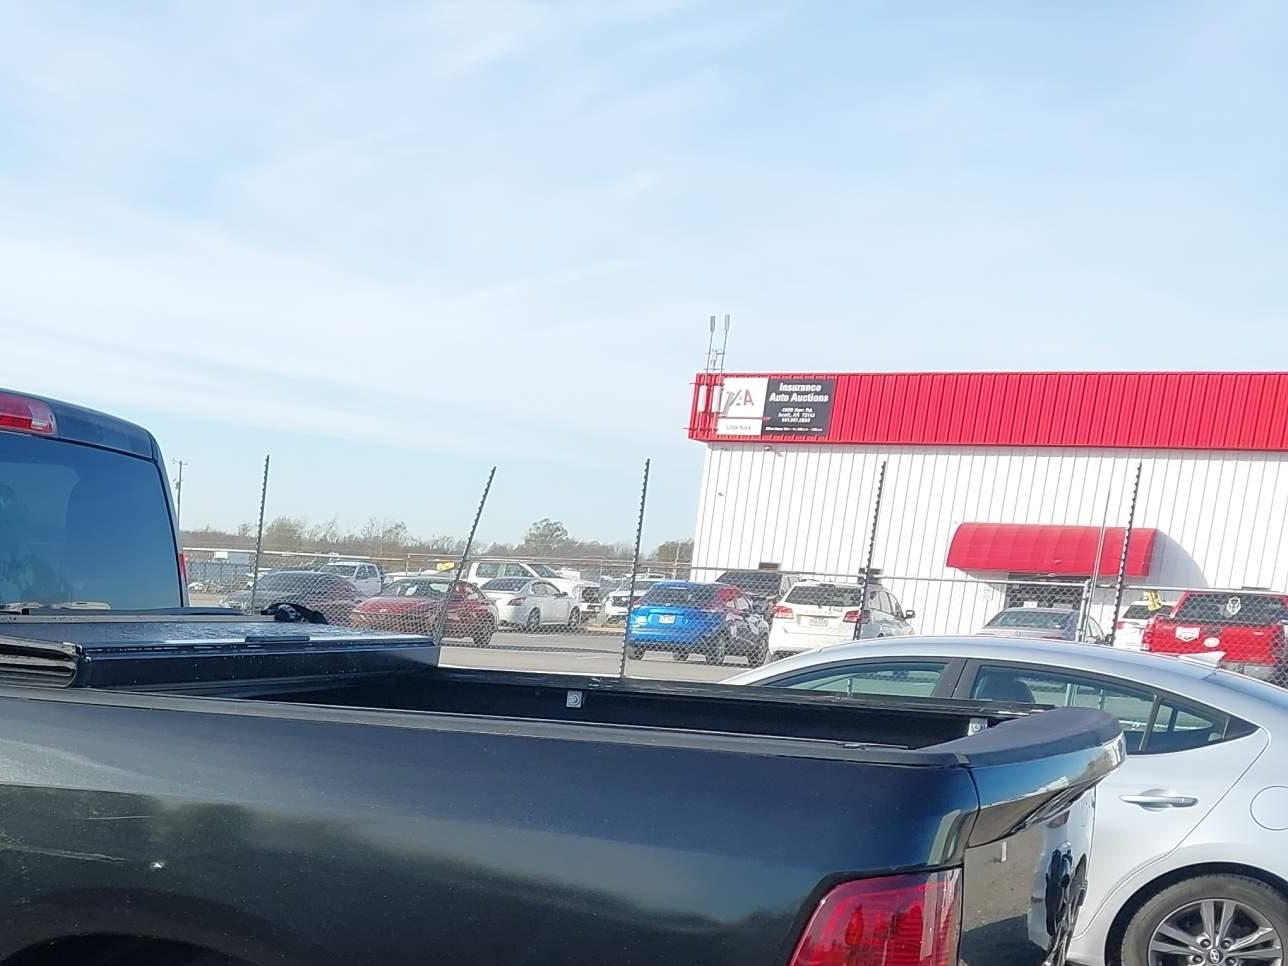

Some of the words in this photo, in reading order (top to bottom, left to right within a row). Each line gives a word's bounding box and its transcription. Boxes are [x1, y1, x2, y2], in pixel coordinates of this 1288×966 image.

[779, 382, 822, 392] Insurance
[769, 392, 789, 402] Auto
[790, 392, 829, 402] Auctions
